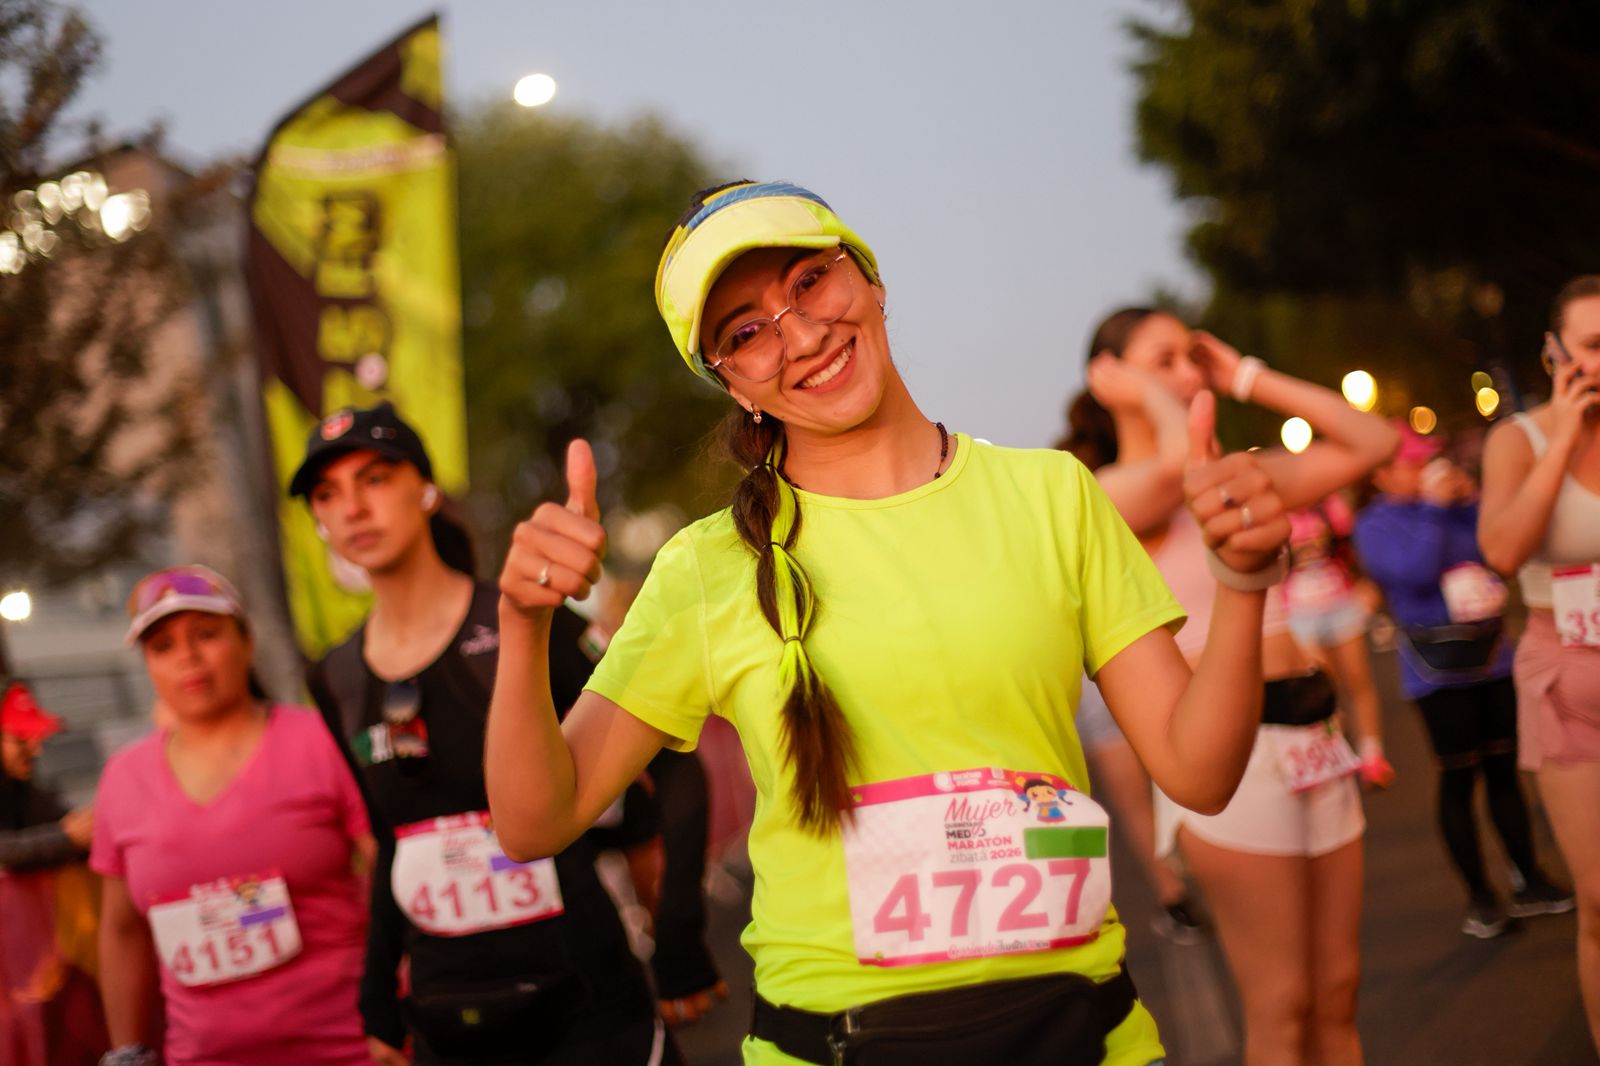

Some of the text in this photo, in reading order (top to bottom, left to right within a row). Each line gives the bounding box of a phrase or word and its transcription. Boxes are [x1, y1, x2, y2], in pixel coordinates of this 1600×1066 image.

[945, 797, 1016, 836] Mujer
[991, 848, 1022, 859] 2026
[410, 867, 541, 921] 4113
[873, 859, 1090, 942] 4727
[172, 922, 280, 974] 4151
